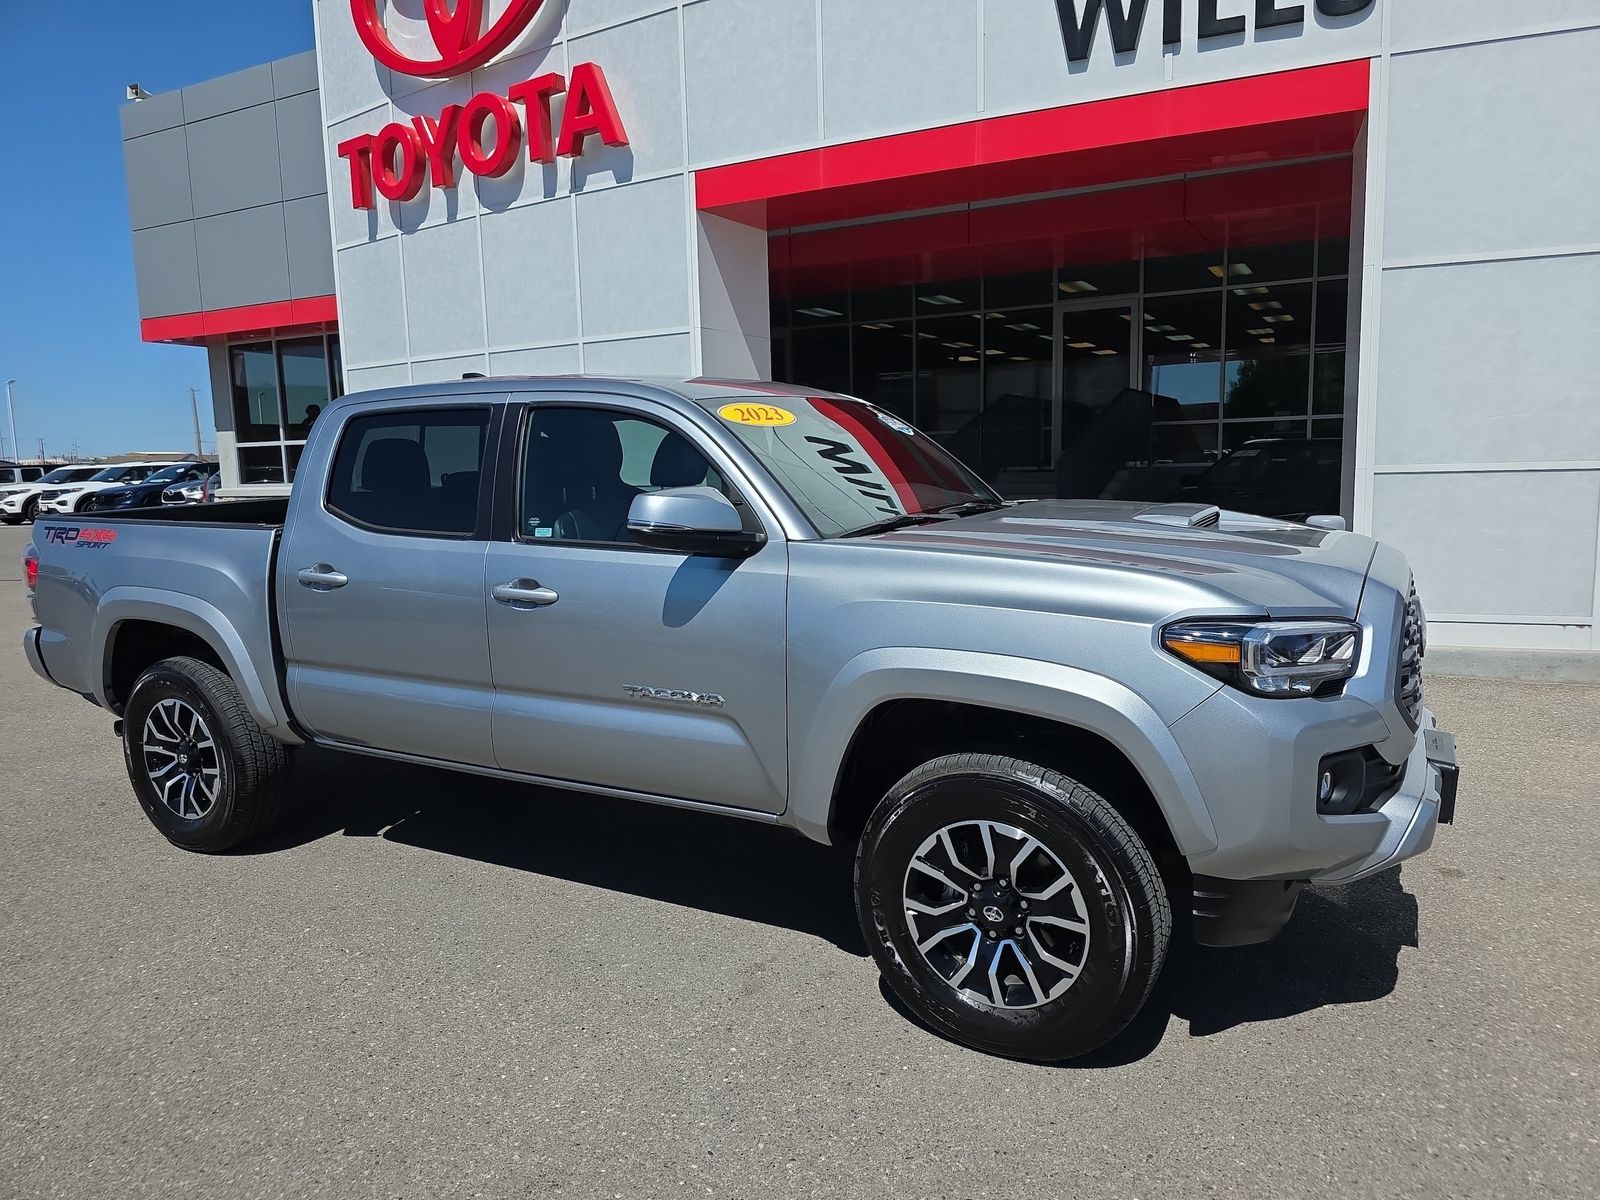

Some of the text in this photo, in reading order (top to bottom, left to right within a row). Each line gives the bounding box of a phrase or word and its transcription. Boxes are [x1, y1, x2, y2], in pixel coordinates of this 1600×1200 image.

[1056, 0, 1375, 62] WILL
[337, 61, 630, 211] TOYOTA
[733, 407, 784, 422] 2023
[44, 526, 81, 545] TRD
[75, 540, 111, 549] SPORT
[622, 683, 727, 707] TACOMA
